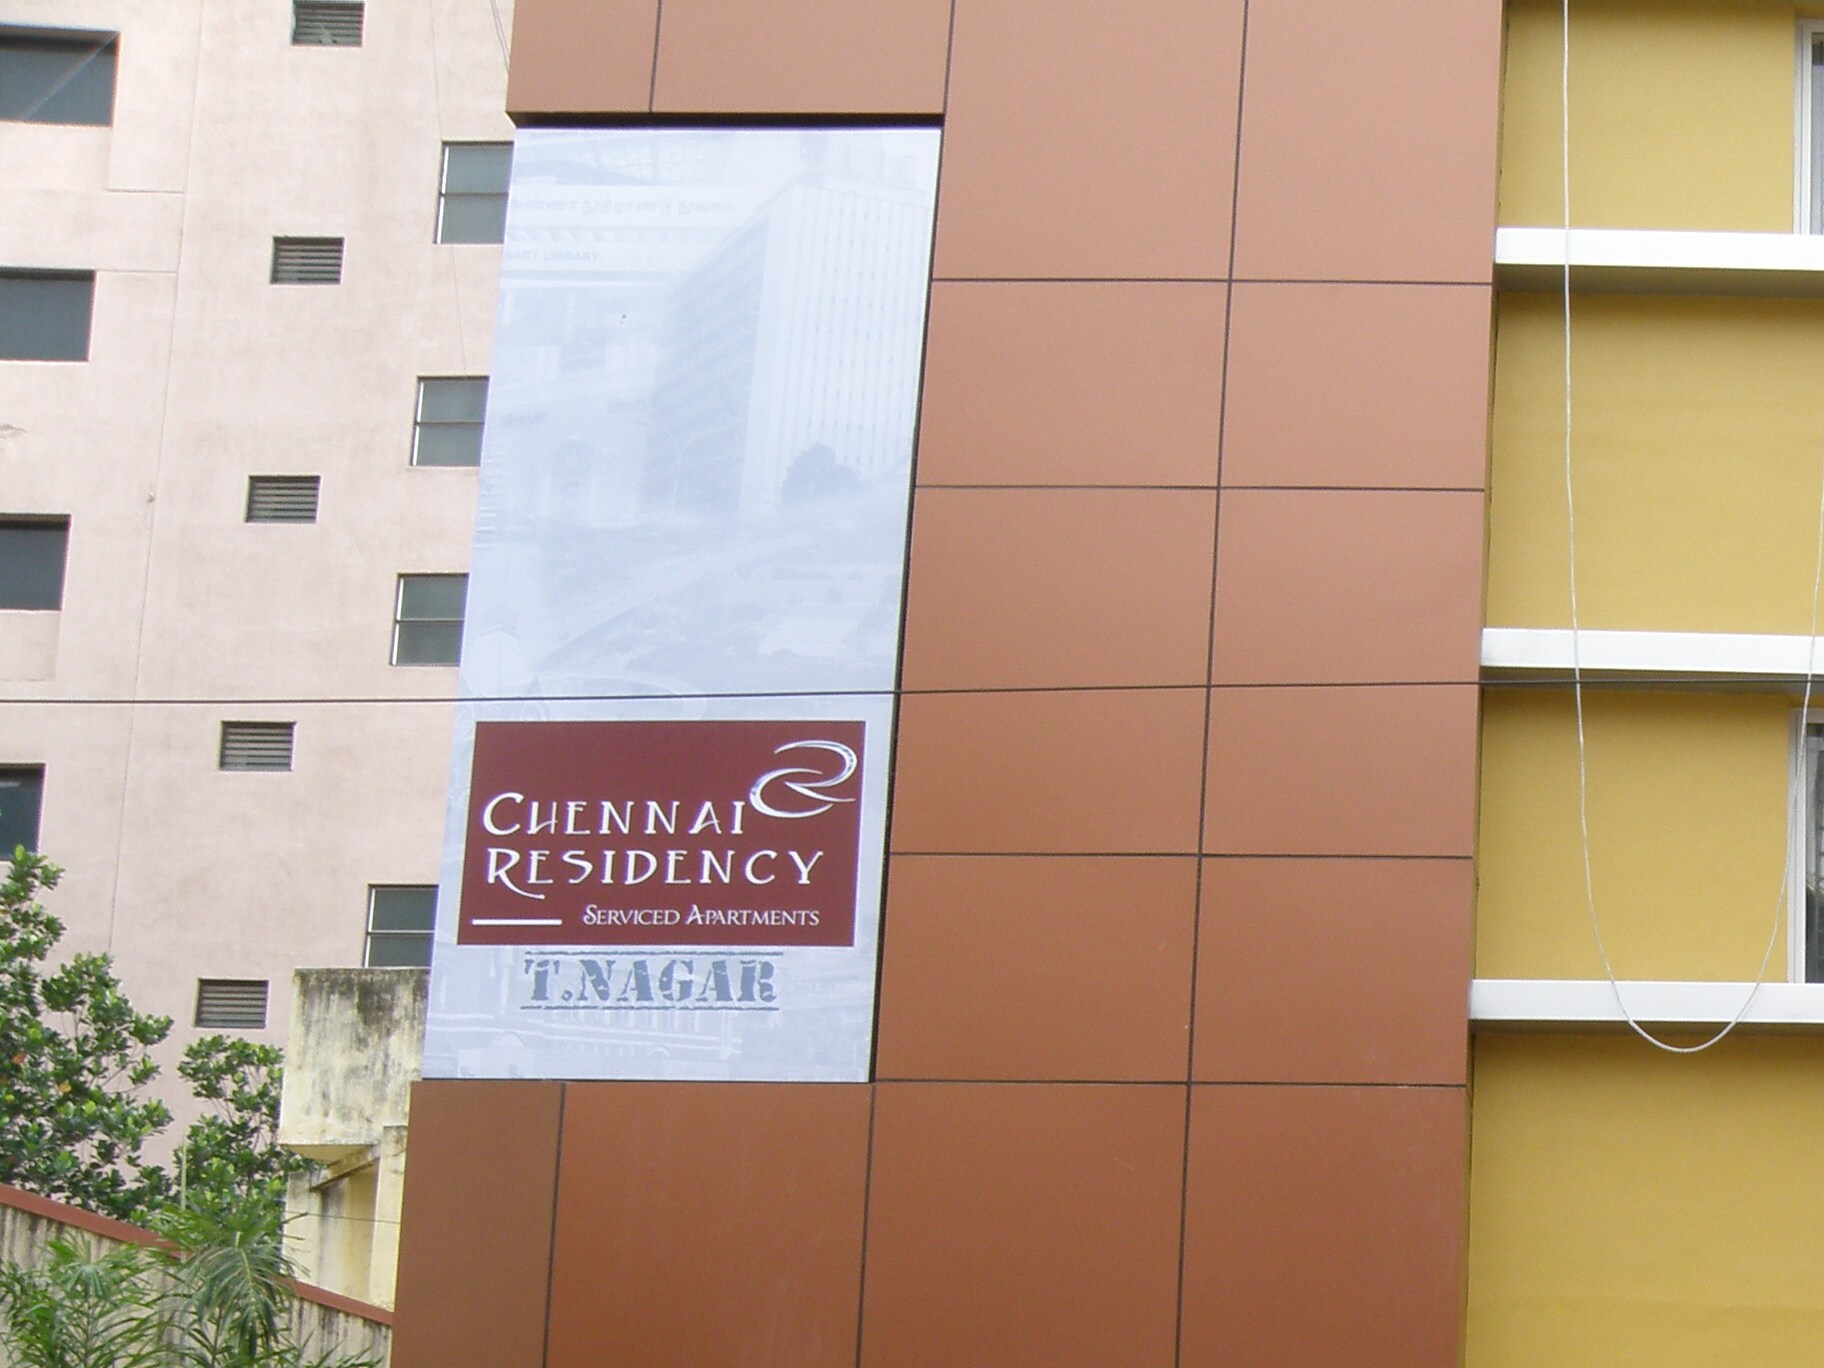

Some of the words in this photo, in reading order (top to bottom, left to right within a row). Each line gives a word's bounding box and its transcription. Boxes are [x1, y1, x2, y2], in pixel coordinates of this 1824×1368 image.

[482, 792, 746, 836] CHENNAI
[486, 847, 824, 900] RESIDENCY
[582, 904, 681, 927] SERVICED
[685, 904, 821, 927] APARTMENTS
[524, 957, 779, 1004] T.NAGAR
